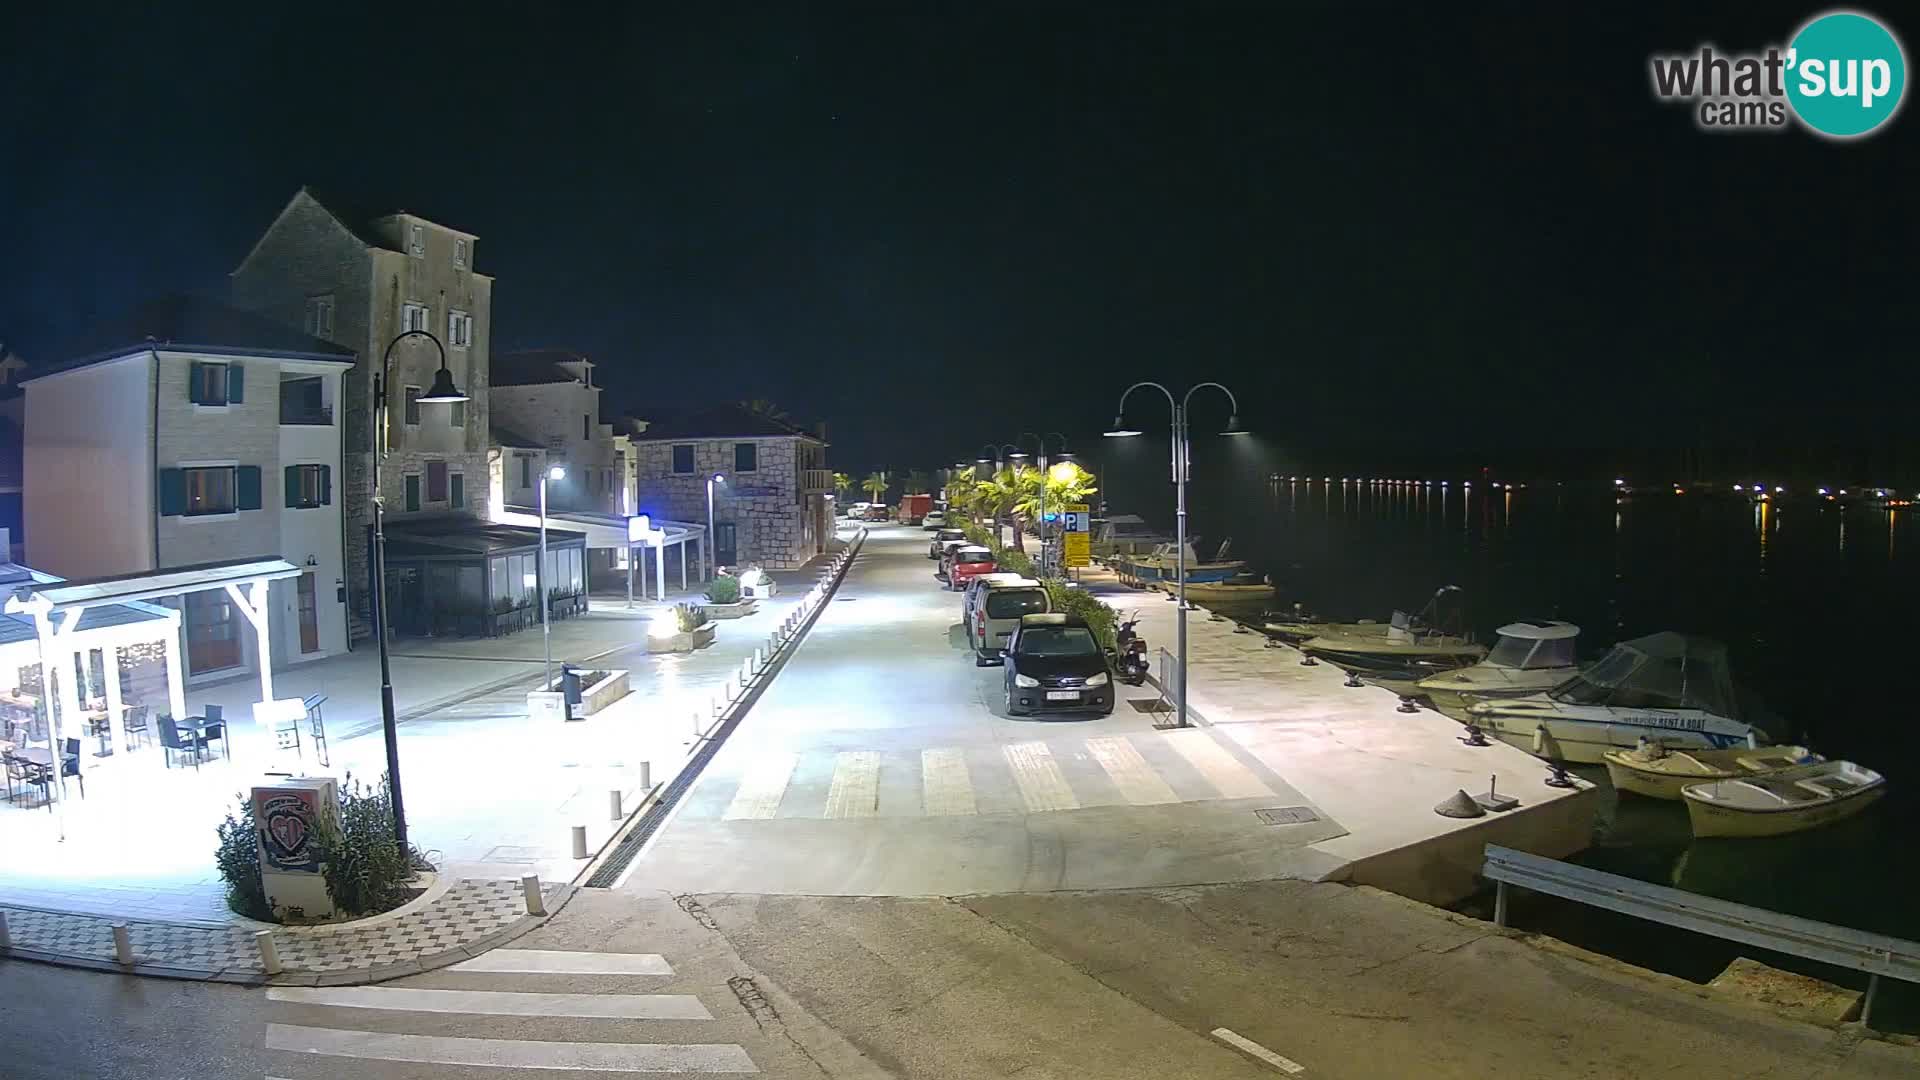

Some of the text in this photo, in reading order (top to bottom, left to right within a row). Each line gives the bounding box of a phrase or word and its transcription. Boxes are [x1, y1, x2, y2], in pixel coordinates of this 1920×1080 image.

[1066, 514, 1077, 530] P
[1659, 717, 1679, 729] RENT
[1680, 719, 1686, 729] A
[1687, 719, 1706, 731] BOAT
